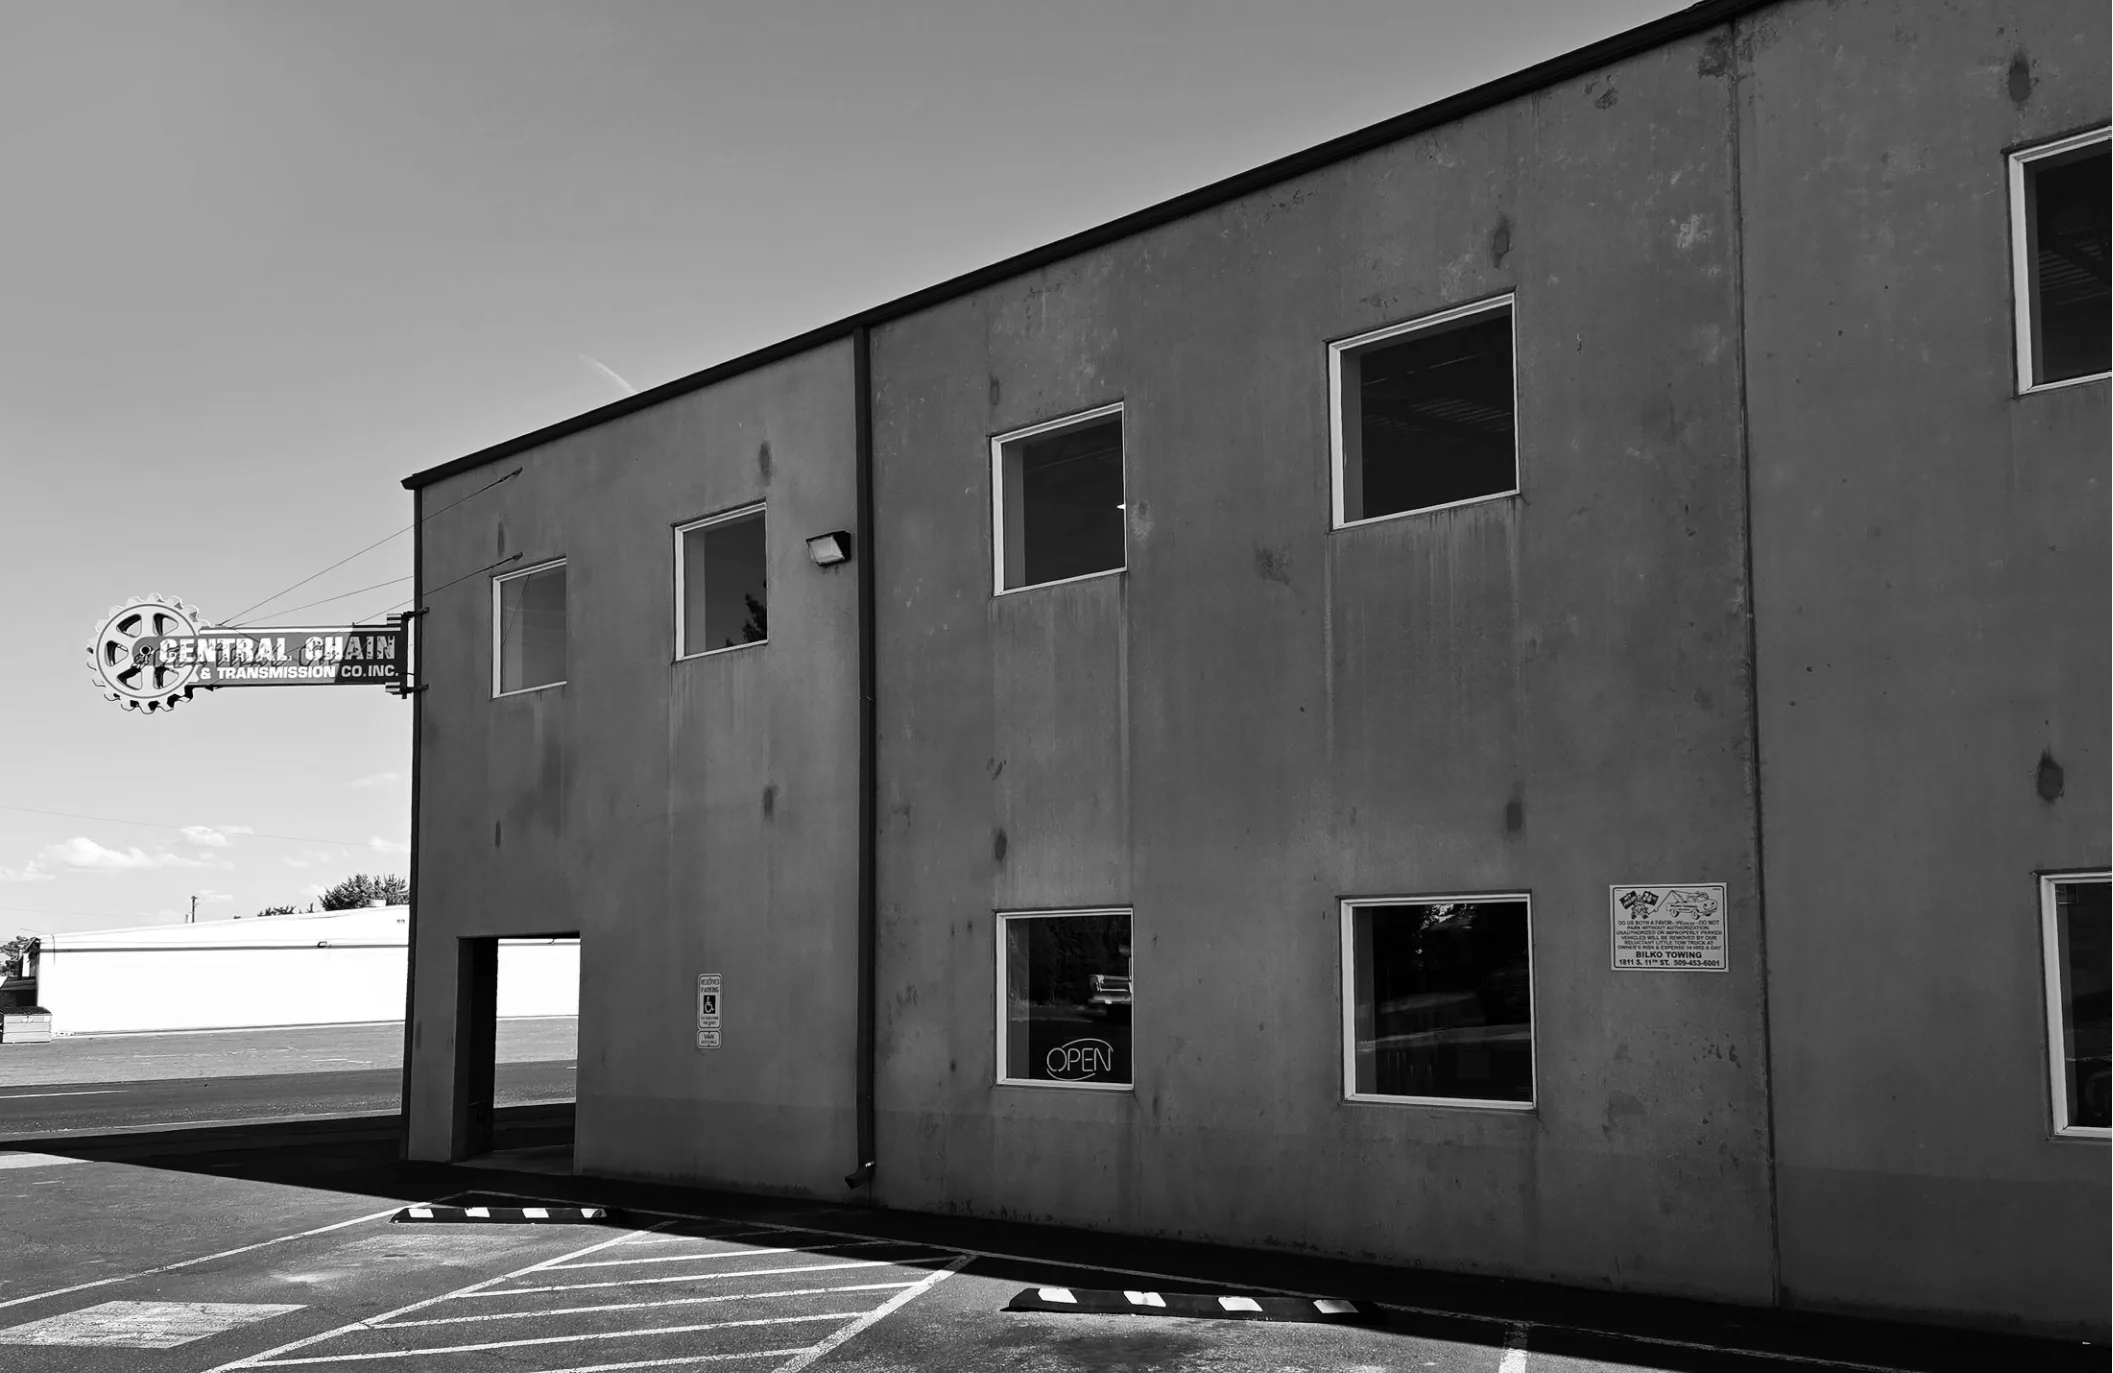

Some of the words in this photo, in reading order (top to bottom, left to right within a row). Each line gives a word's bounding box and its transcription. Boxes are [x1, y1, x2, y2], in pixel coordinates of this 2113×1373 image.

[159, 637, 292, 663] CENTRAL
[305, 635, 396, 660] CHAIN
[201, 668, 211, 680] &
[217, 666, 335, 680] TRANSMISSION
[1046, 1047, 1111, 1072] OPEN
